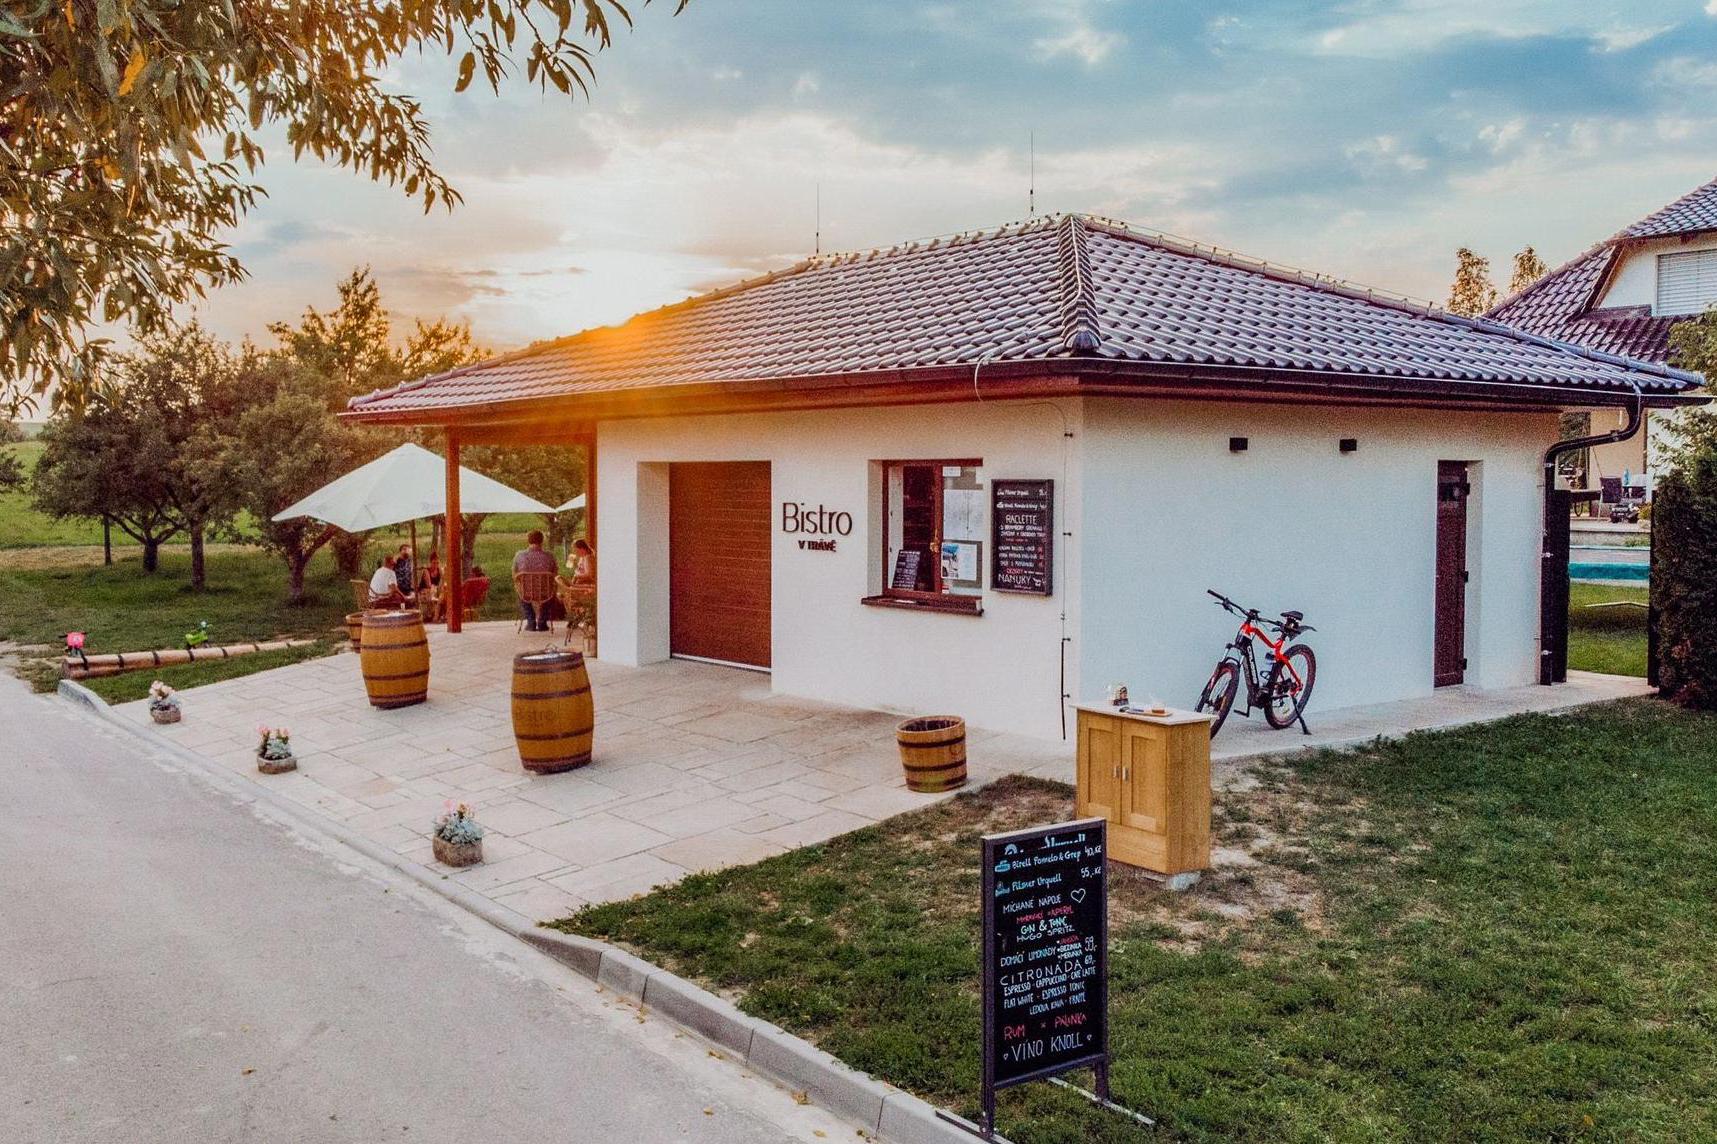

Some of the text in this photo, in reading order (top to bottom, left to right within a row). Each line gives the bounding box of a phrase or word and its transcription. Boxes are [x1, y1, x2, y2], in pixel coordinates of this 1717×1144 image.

[782, 502, 853, 536] Bistro
[1005, 514, 1037, 525] RACLETTE
[798, 540, 806, 550] V
[998, 574, 1032, 586] NANUKY
[1012, 857, 1032, 870] Birell
[1064, 850, 1081, 862] Grep
[1012, 879, 1035, 891] Pilsner
[1037, 873, 1062, 888] Urquell
[1016, 924, 1075, 943] HUGO SPRITZ
[1020, 916, 1068, 935] GIN & TONIC
[1003, 982, 1031, 996] ESPRESSO
[1003, 998, 1016, 1009] FLAT
[1041, 985, 1067, 1000] ESPRESSO
[1003, 1024, 1026, 1040] RUM
[1050, 1032, 1084, 1052] KNOLL
